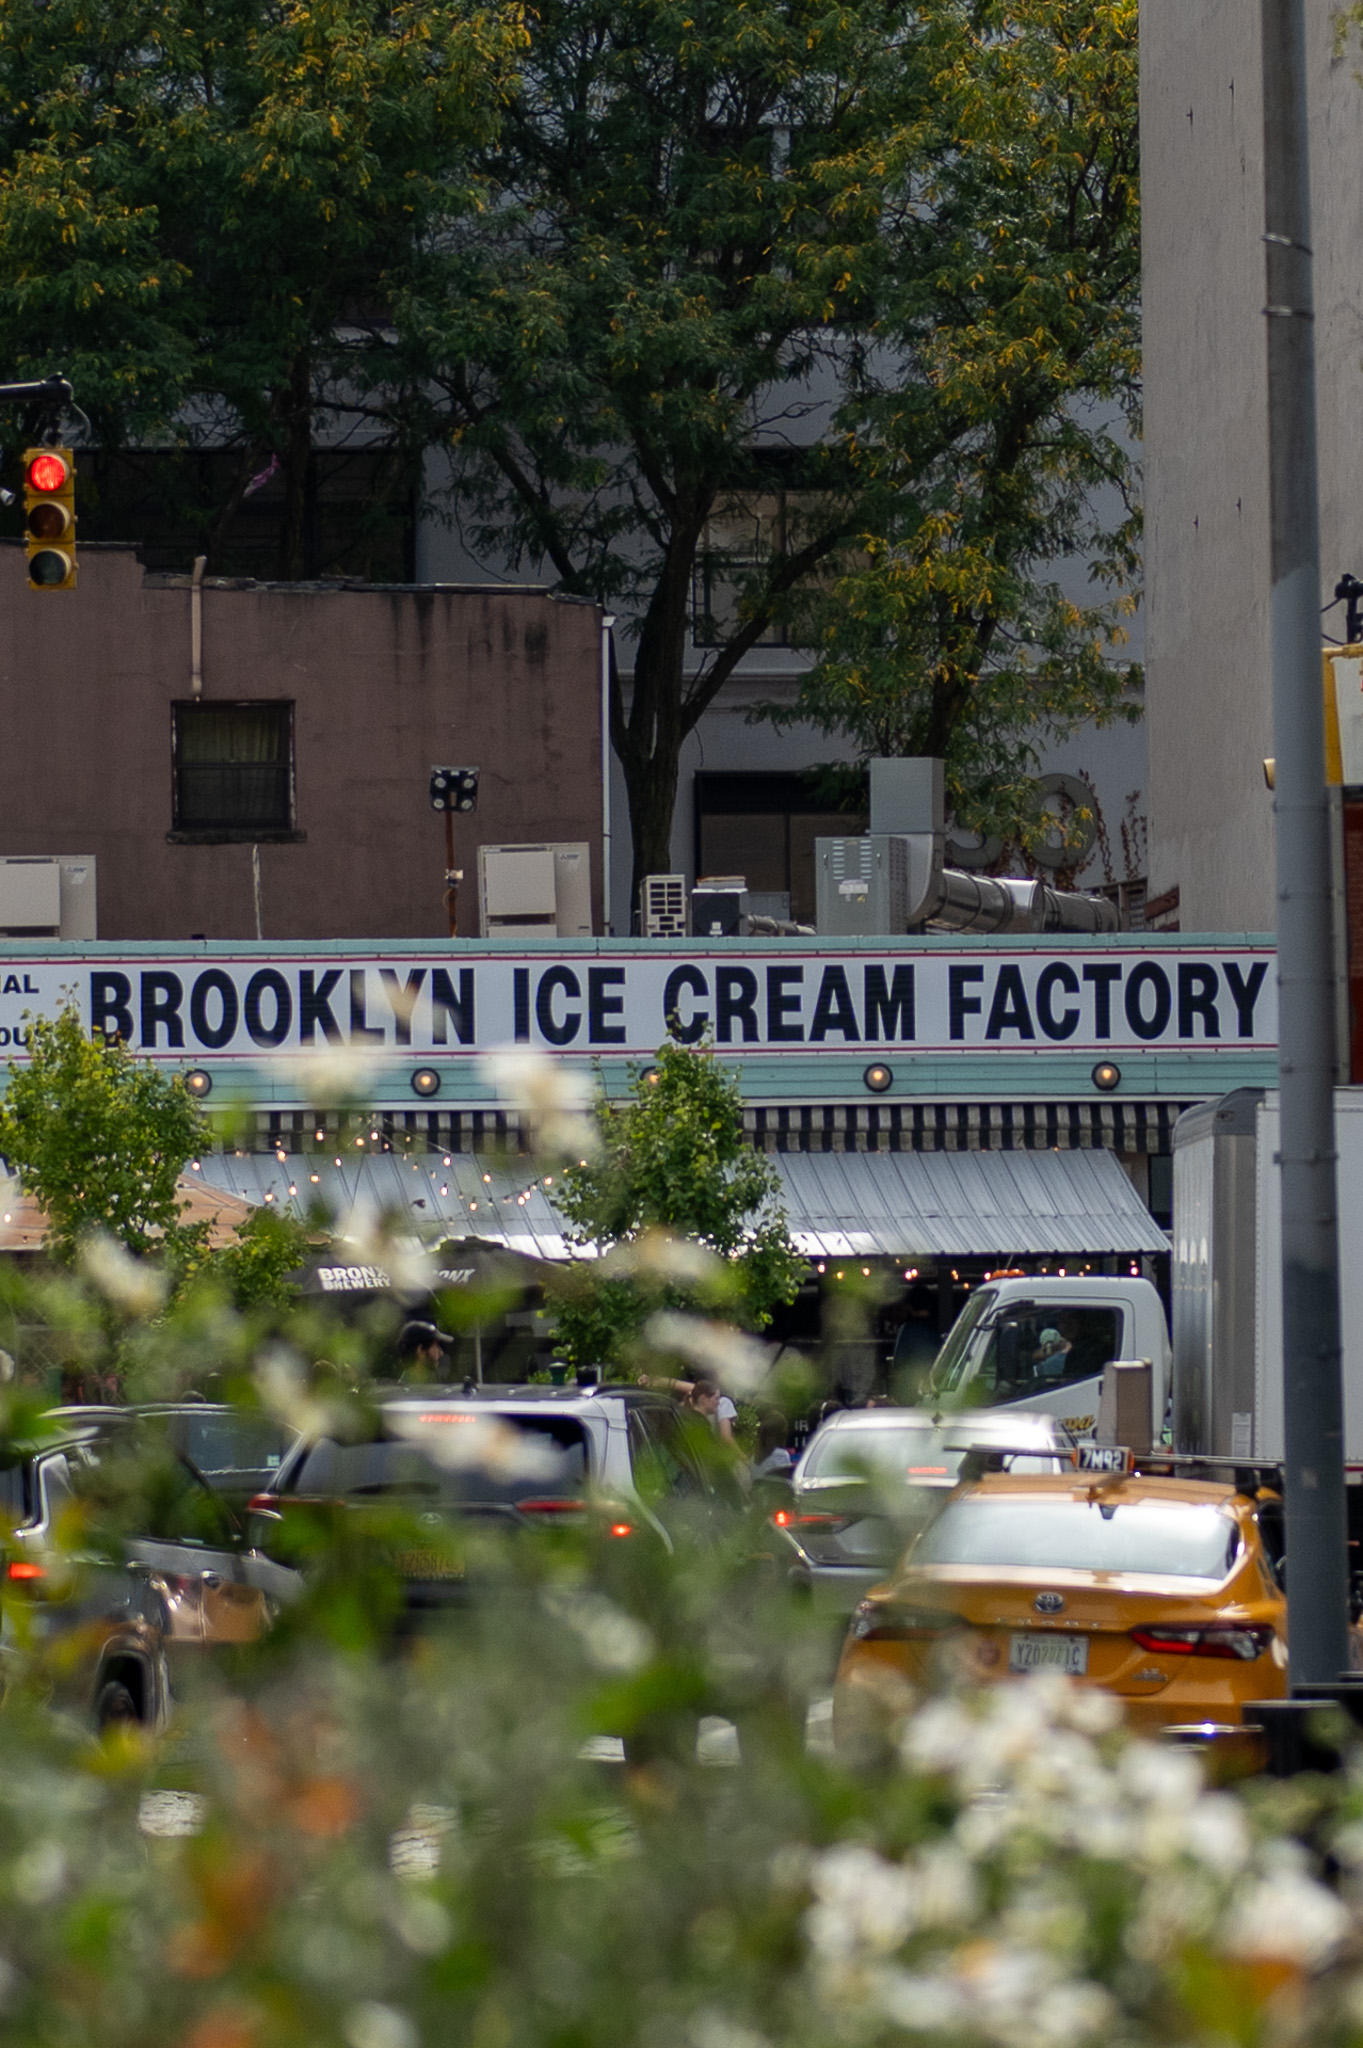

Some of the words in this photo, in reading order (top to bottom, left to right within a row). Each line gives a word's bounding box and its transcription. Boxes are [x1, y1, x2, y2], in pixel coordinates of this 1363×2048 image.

[0, 974, 40, 994] AL
[90, 968, 475, 1049] BROOKLYN
[513, 965, 626, 1046] ICE
[663, 963, 916, 1044] CREAM
[948, 960, 1269, 1040] FACTORY
[317, 1266, 388, 1282] BRONX
[322, 1277, 391, 1291] BREWERY
[1082, 1448, 1122, 1471] 7M92
